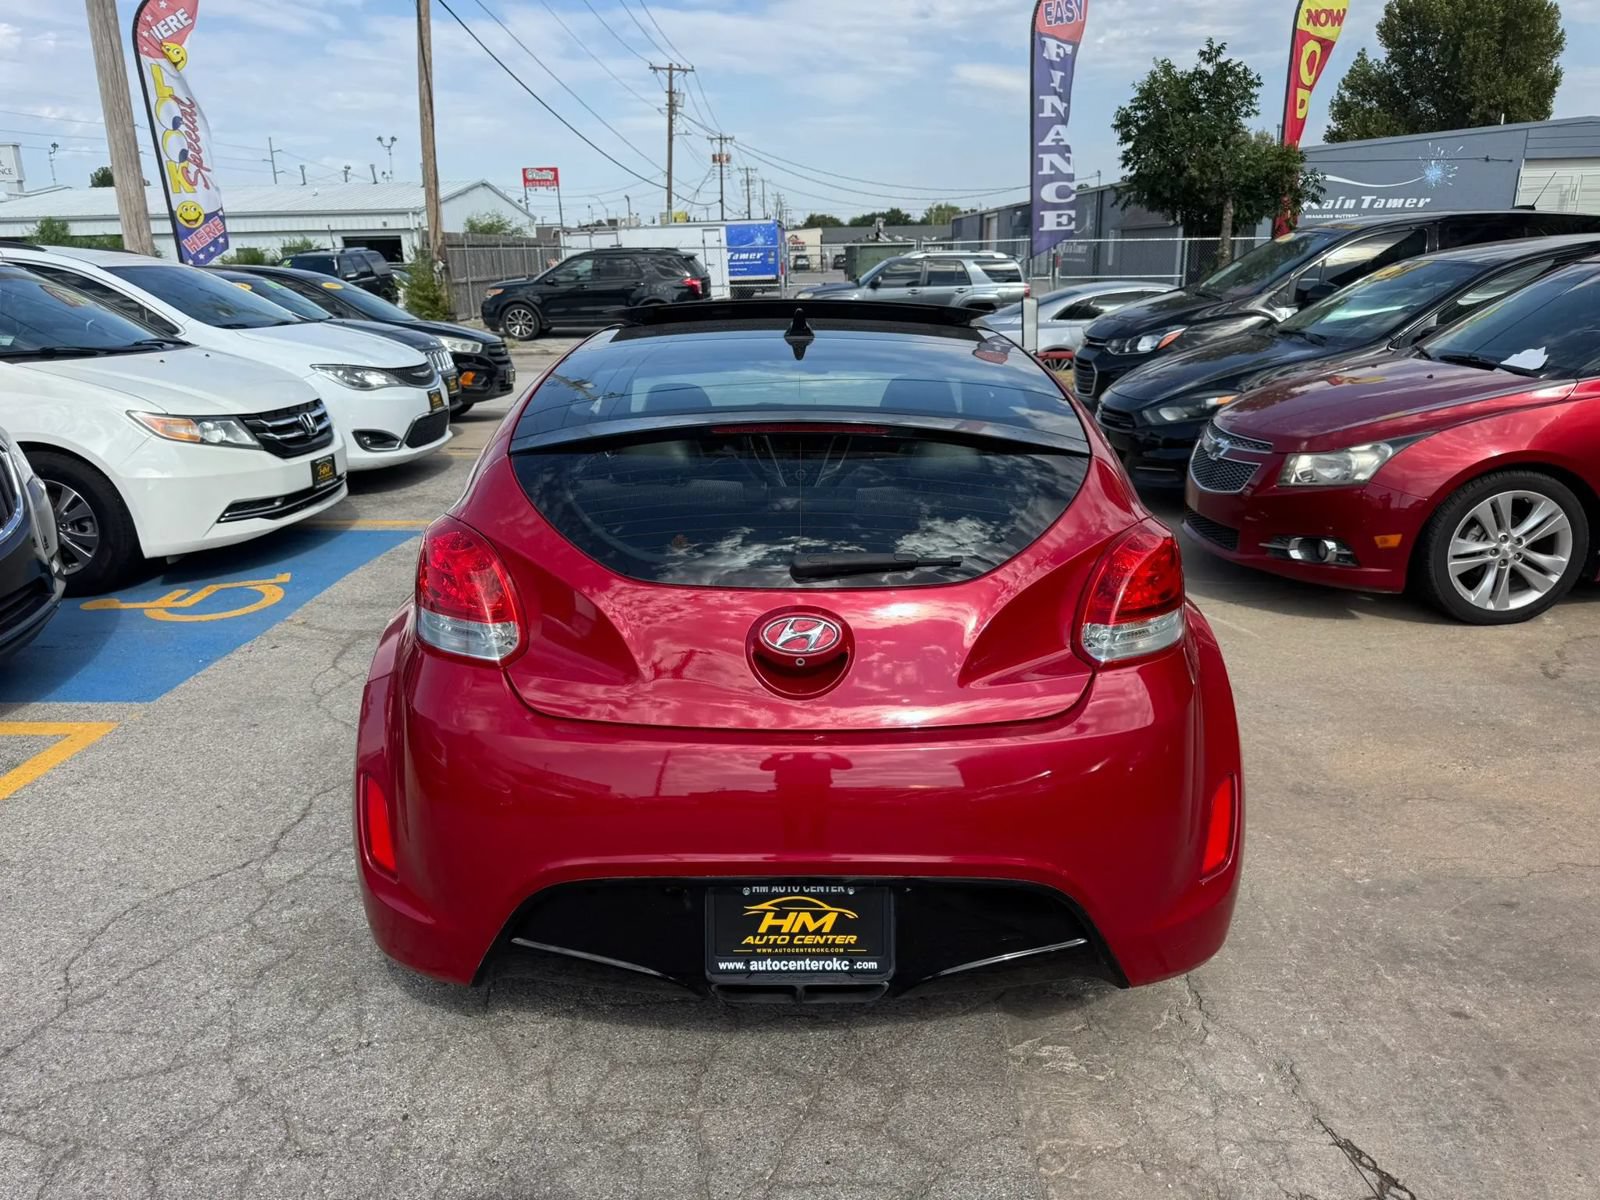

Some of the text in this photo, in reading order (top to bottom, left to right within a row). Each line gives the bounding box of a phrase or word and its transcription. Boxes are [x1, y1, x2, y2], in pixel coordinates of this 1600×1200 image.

[1043, 0, 1085, 26] EASY
[1306, 8, 1346, 27] NOW
[150, 63, 197, 193] LOOK
[1038, 37, 1076, 231] FINANCE
[1361, 195, 1431, 209] Tamer
[182, 215, 225, 254] HERE
[727, 251, 764, 260] Tamer
[757, 911, 839, 933] HM
[741, 935, 858, 945] AUTO CENTER
[718, 957, 878, 971] www. autocenterokc .com
